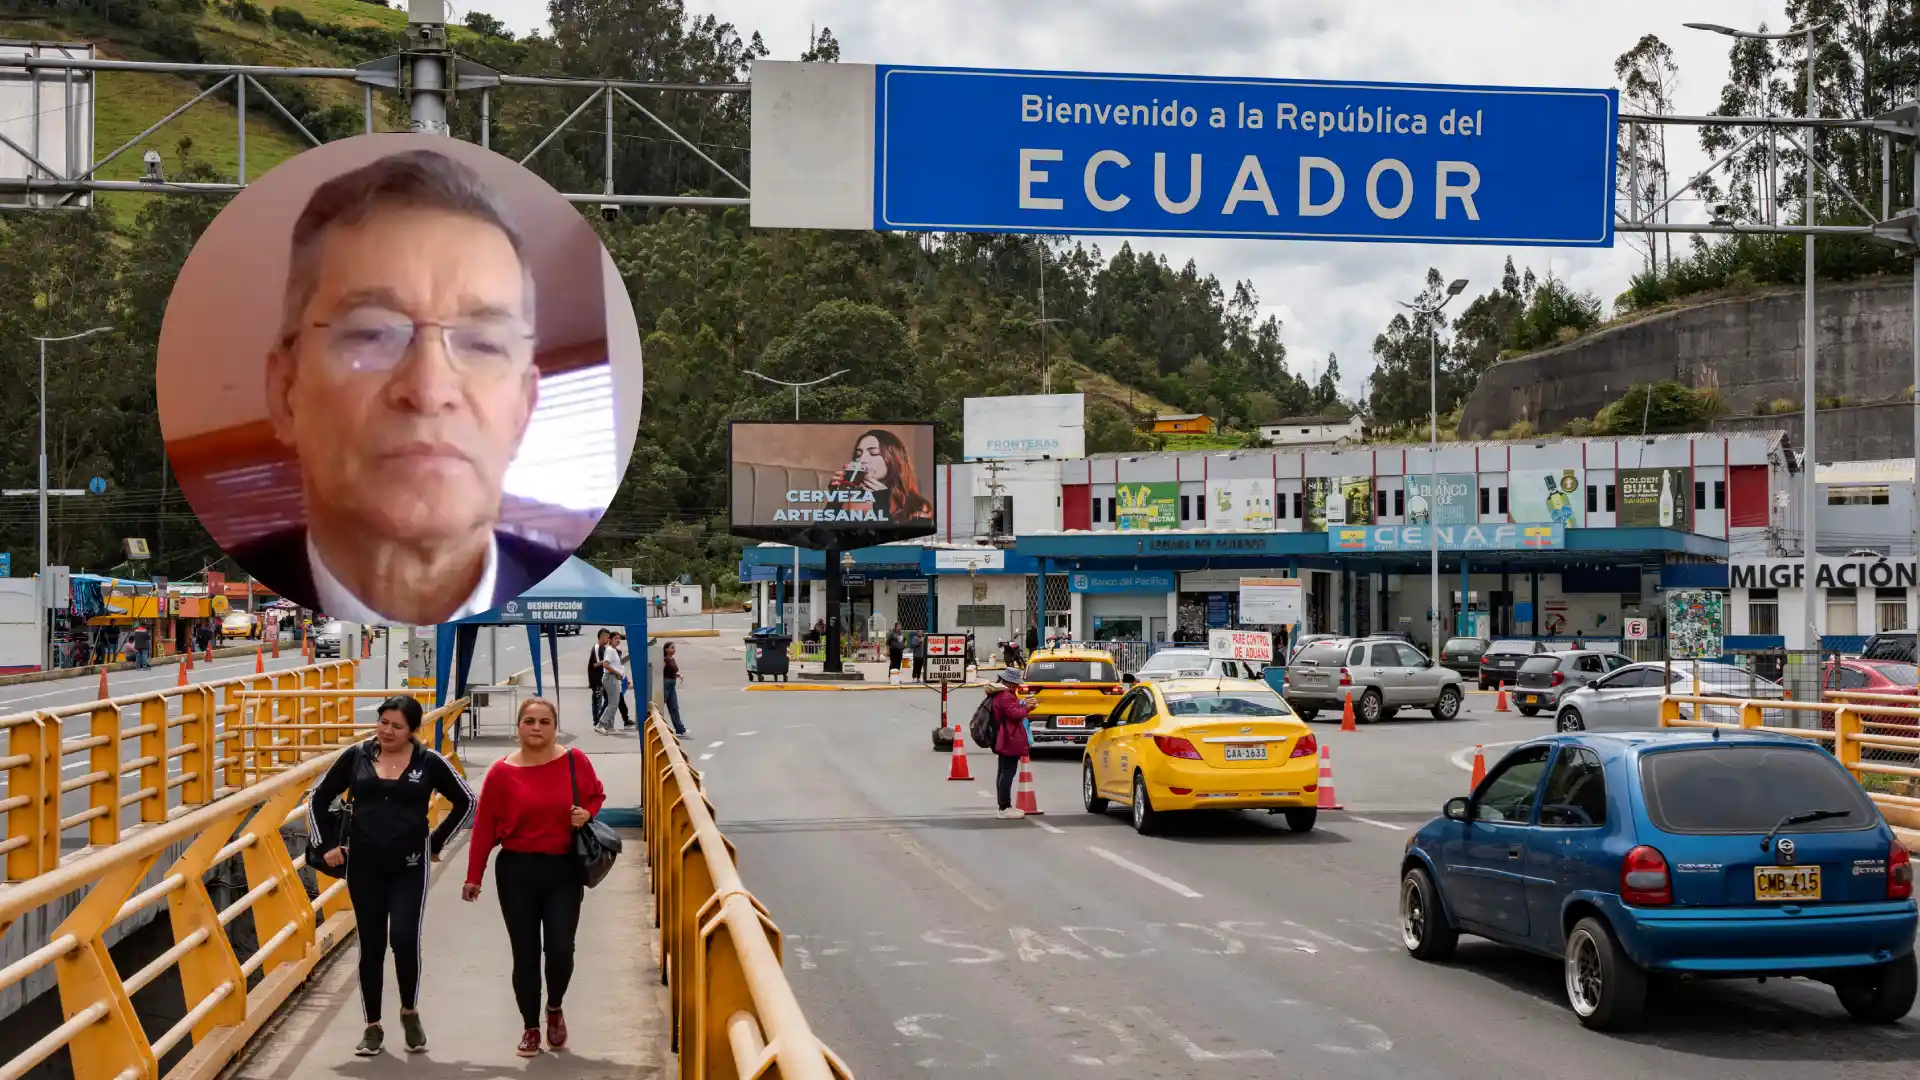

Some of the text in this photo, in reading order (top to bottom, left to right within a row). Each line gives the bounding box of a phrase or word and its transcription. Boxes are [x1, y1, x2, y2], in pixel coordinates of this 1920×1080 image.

[1021, 94, 1482, 138] Bienvenido a la República del
[1020, 148, 1481, 221] ECUADOR
[986, 439, 1060, 449] FRONTERAS
[1420, 484, 1468, 497] BLANCO
[1623, 484, 1659, 494] BULL
[786, 490, 877, 502] CERVEZA
[772, 509, 889, 522] ARTESANAL
[1091, 578, 1117, 587] Banco
[527, 600, 583, 610] DESINFECCIÓN
[532, 611, 542, 620] DE
[543, 611, 578, 619] CALZADO
[1631, 623, 1641, 634] E
[1232, 633, 1270, 647] PARE CONTROL
[1234, 646, 1270, 660] DE ADUANA
[1225, 748, 1267, 759] CAA-1633
[1758, 872, 1818, 891] CMB 415
